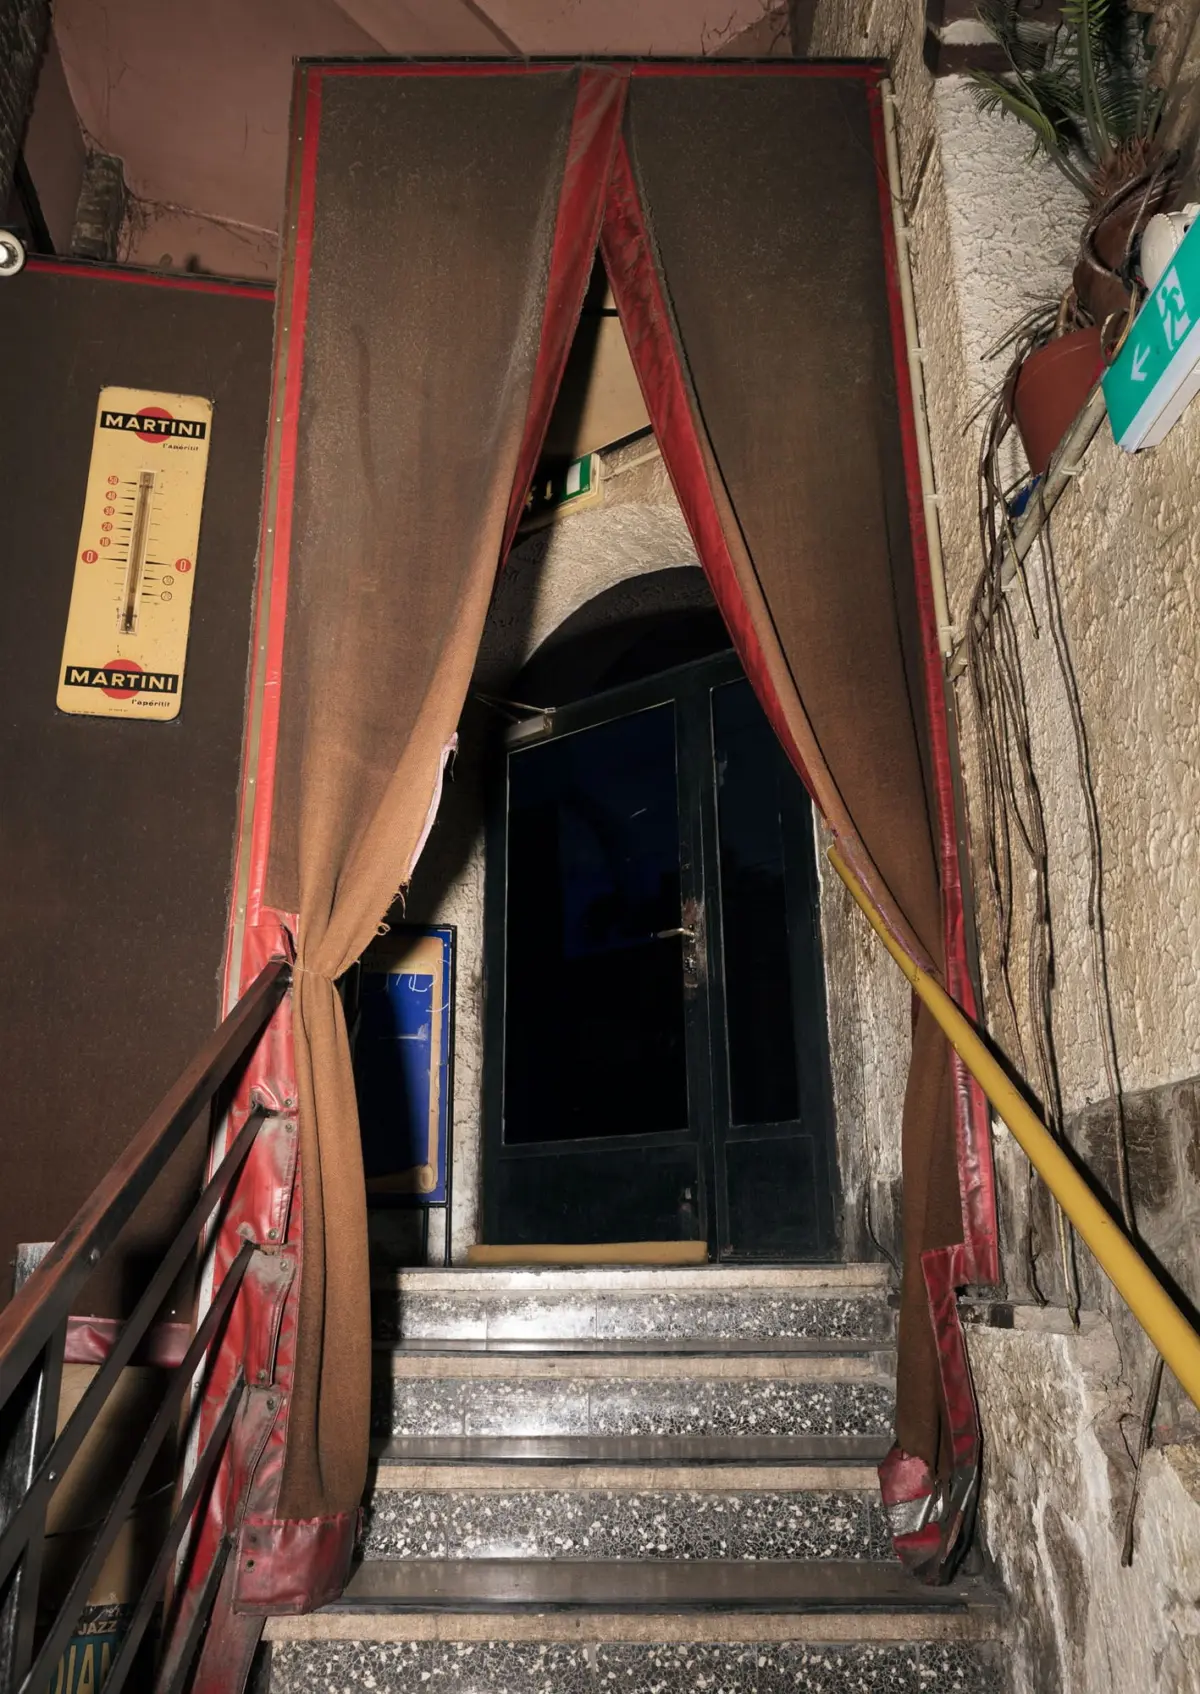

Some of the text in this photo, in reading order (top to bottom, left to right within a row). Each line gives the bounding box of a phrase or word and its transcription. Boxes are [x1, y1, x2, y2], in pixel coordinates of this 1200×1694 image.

[105, 414, 200, 437] MARTINI
[162, 443, 200, 452] l'apéritif
[108, 476, 118, 485] 50
[106, 492, 116, 500] 40
[104, 506, 114, 515] 30
[102, 522, 112, 531] 20
[101, 537, 110, 546] 10
[70, 669, 173, 691] MARTINI
[131, 698, 171, 708] l'apéritif
[78, 1620, 118, 1635] JAZZ
